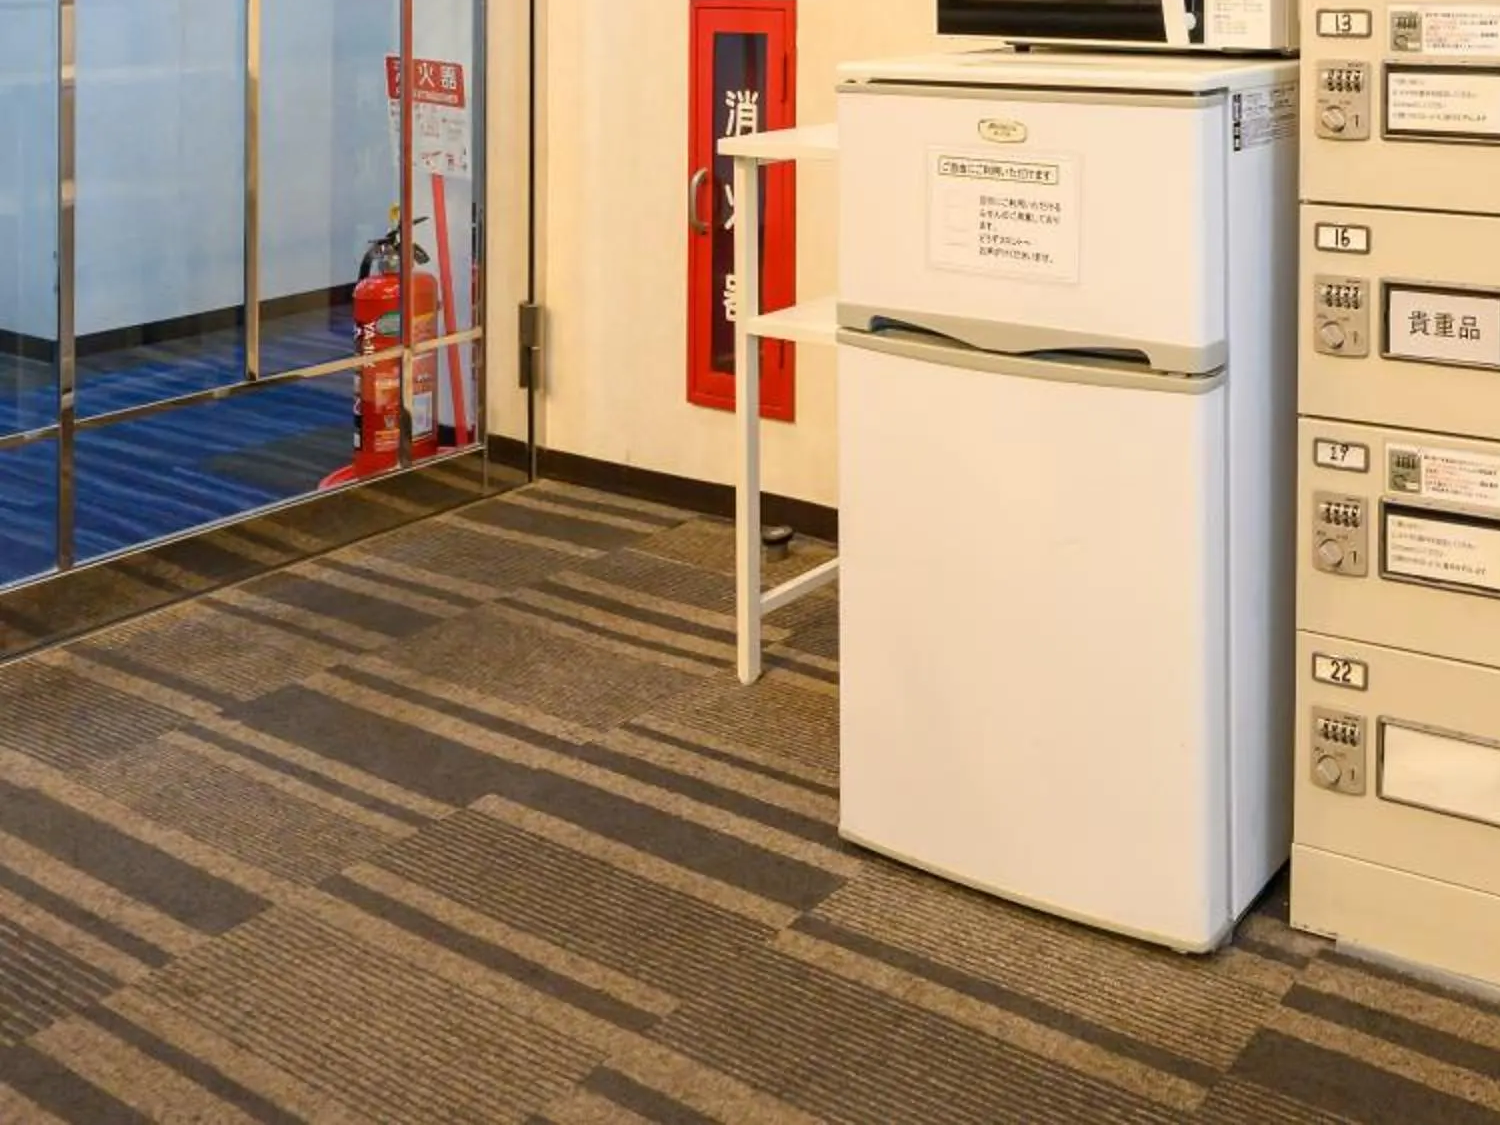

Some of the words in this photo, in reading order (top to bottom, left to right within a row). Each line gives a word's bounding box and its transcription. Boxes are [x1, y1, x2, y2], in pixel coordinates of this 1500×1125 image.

[1335, 13, 1352, 32] 13
[394, 61, 458, 90] 火器
[1335, 228, 1351, 247] 16
[1407, 309, 1481, 341] 貴重品
[1331, 660, 1351, 683] 22
